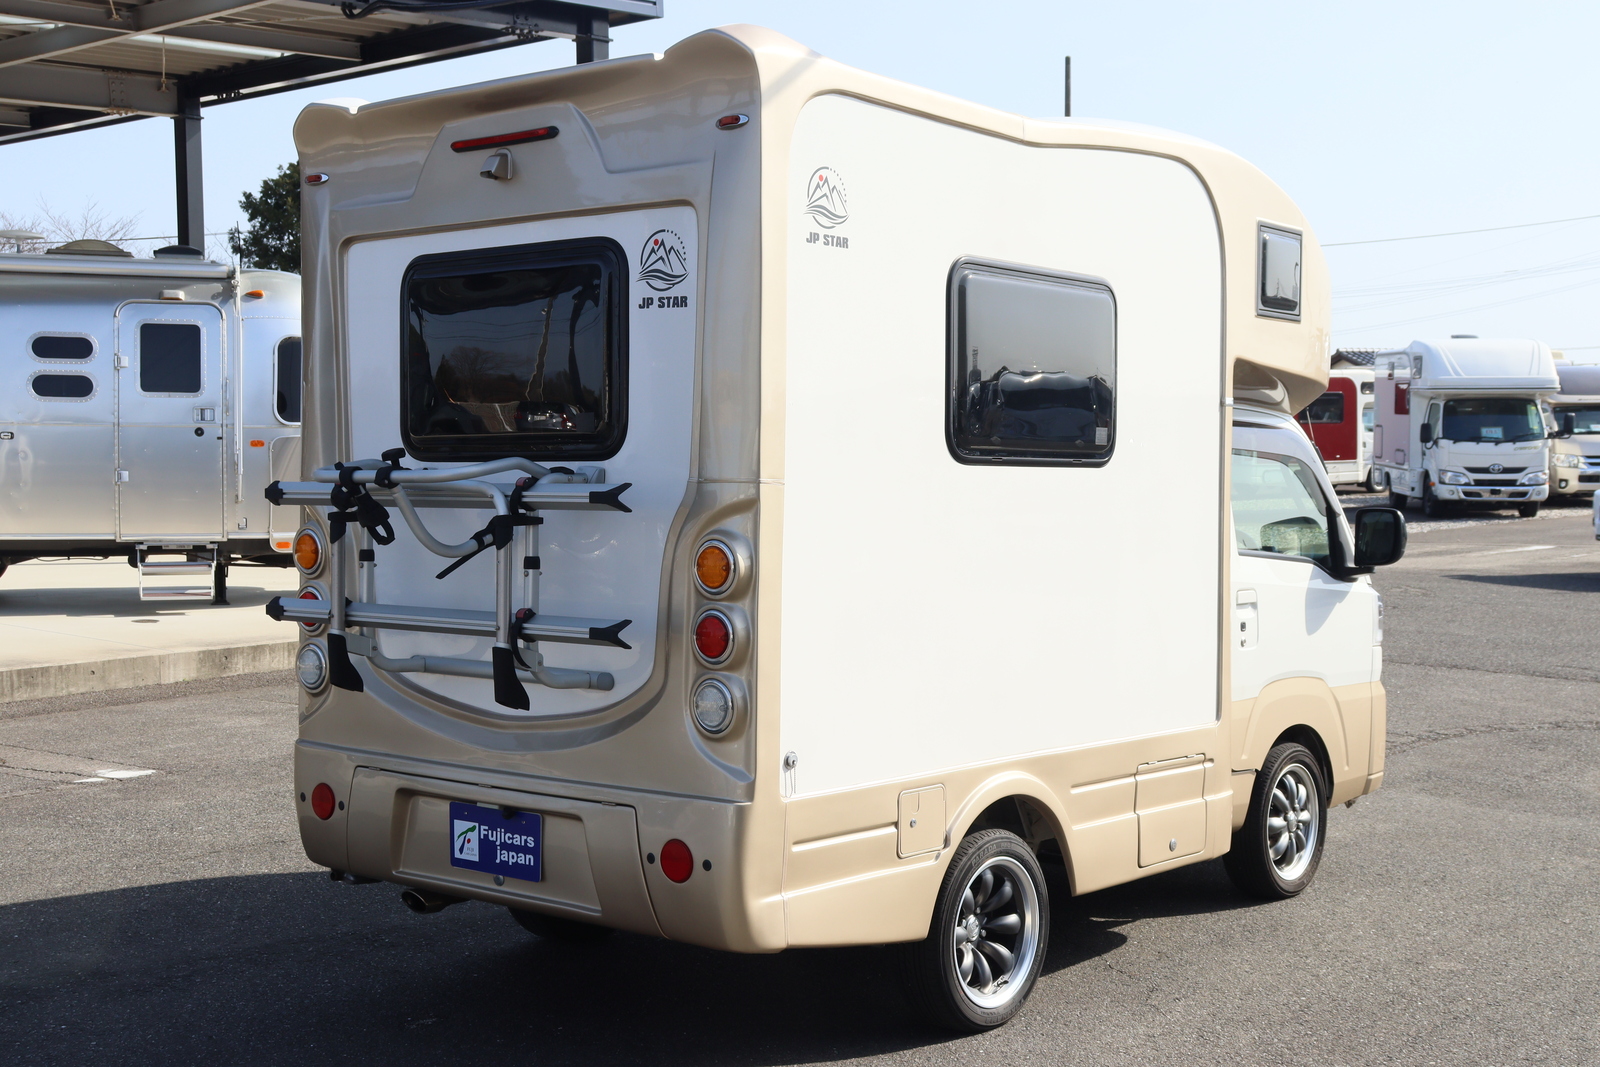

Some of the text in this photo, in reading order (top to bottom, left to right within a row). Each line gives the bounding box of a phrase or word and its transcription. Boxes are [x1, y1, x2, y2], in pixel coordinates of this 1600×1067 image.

[806, 231, 849, 249] JP STAR
[639, 296, 688, 309] JP STAR
[480, 825, 535, 848] Fujicars
[496, 846, 534, 866] japan
